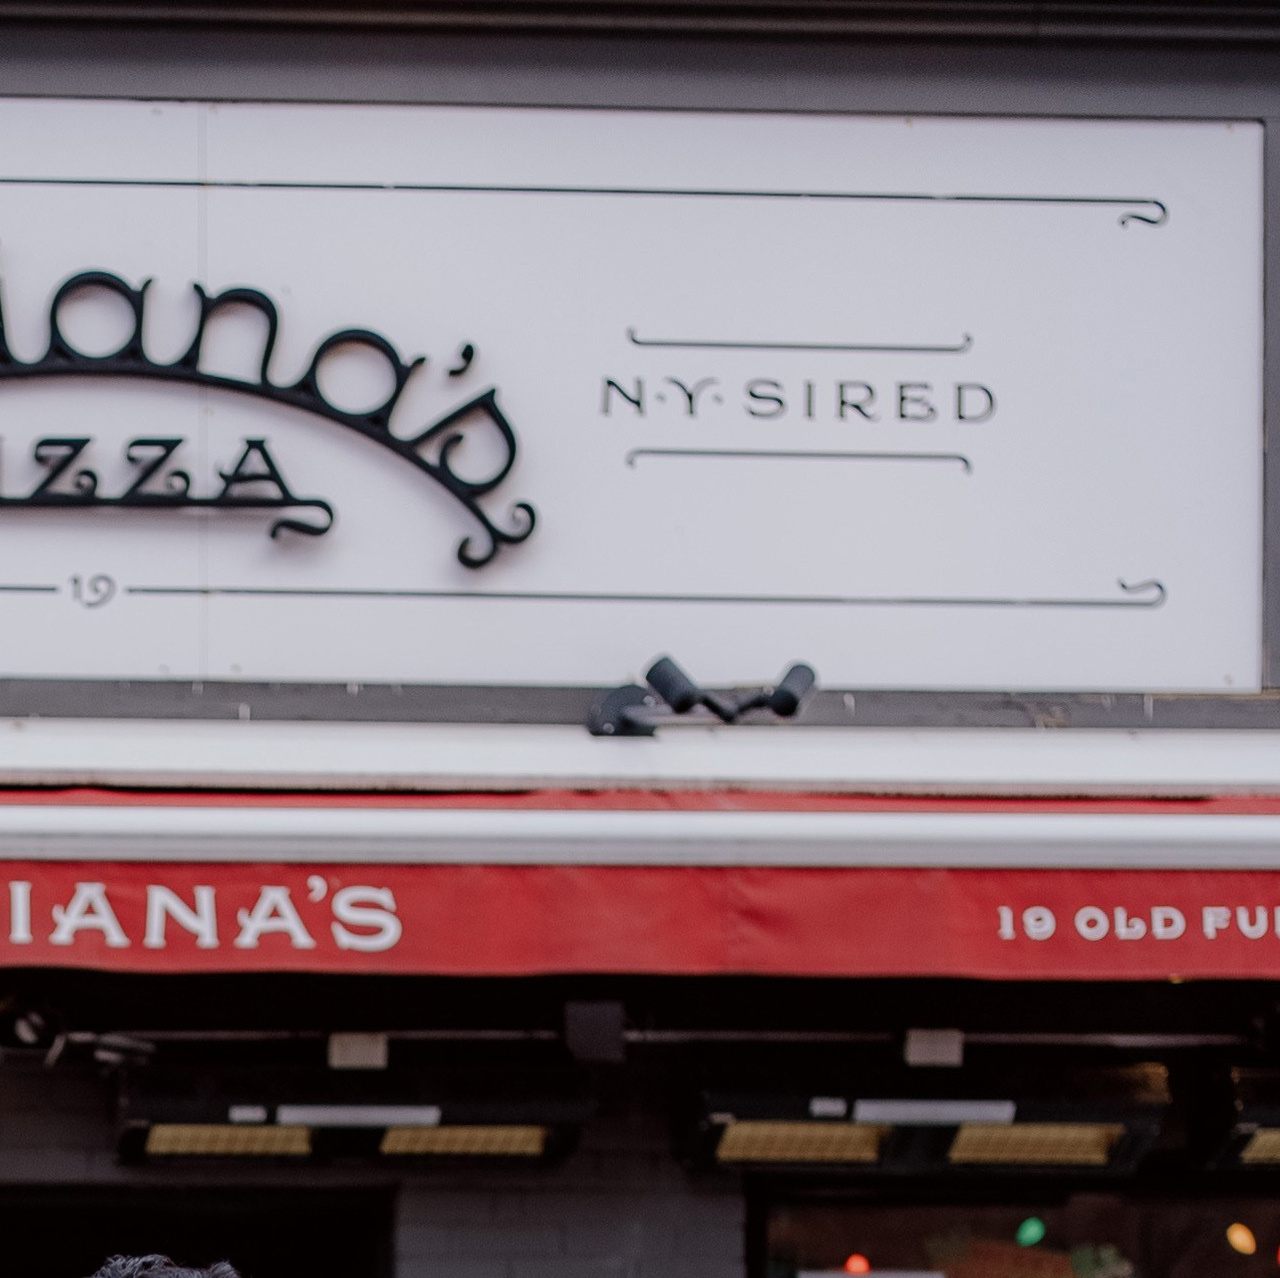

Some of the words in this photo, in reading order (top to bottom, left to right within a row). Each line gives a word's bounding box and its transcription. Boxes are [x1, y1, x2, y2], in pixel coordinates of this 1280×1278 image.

[744, 378, 997, 423] SIRED
[70, 573, 116, 608] 19
[996, 905, 1056, 941] 19
[1074, 905, 1187, 941] OLD
[1202, 905, 1280, 941] FU
